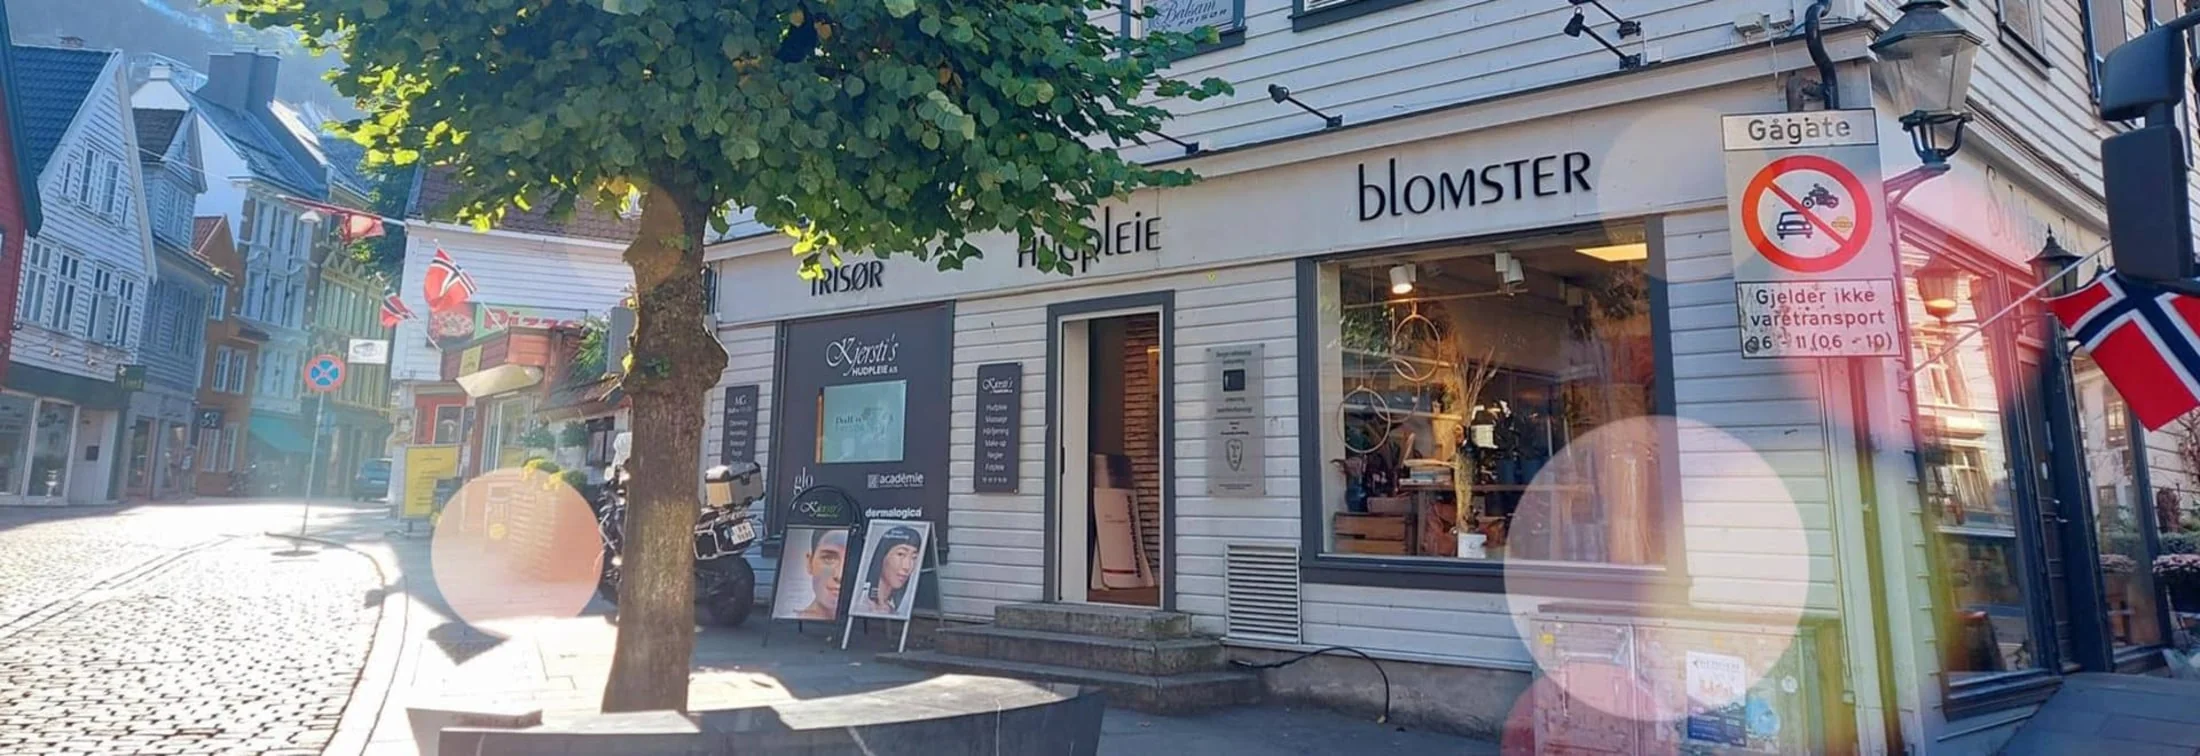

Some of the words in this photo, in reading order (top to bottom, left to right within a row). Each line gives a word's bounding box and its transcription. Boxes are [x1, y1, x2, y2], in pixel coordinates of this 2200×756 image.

[1748, 116, 1851, 145] Gågate
[1755, 287, 1826, 306] Gjelder
[1834, 288, 1875, 302] ikke
[1750, 311, 1885, 328] varetransport
[826, 333, 899, 377] Kjersti's
[865, 507, 923, 519] dermalogica
